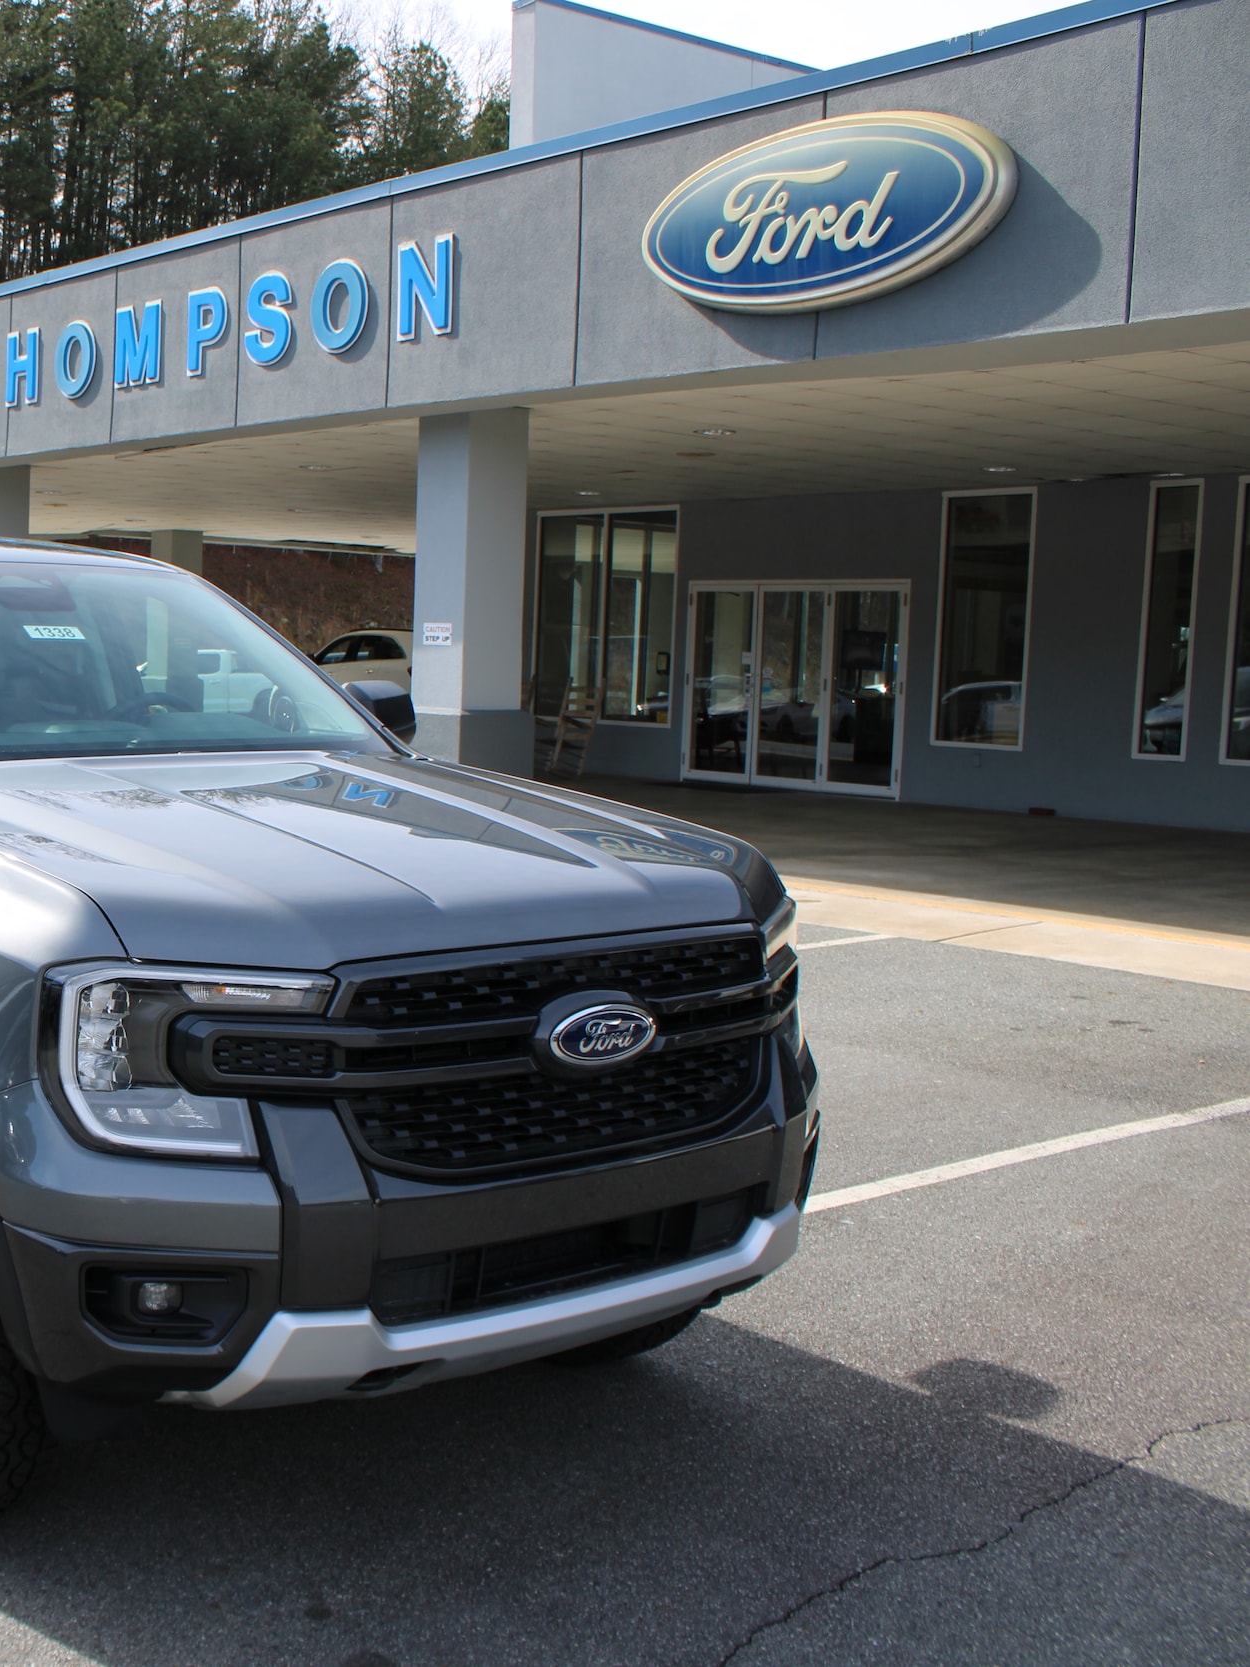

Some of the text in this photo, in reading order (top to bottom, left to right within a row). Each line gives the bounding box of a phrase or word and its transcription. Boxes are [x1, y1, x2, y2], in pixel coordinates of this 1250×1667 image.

[705, 160, 900, 275] Ford
[34, 627, 75, 638] 1338
[425, 625, 451, 633] CAUTION
[579, 1018, 636, 1053] Ford
